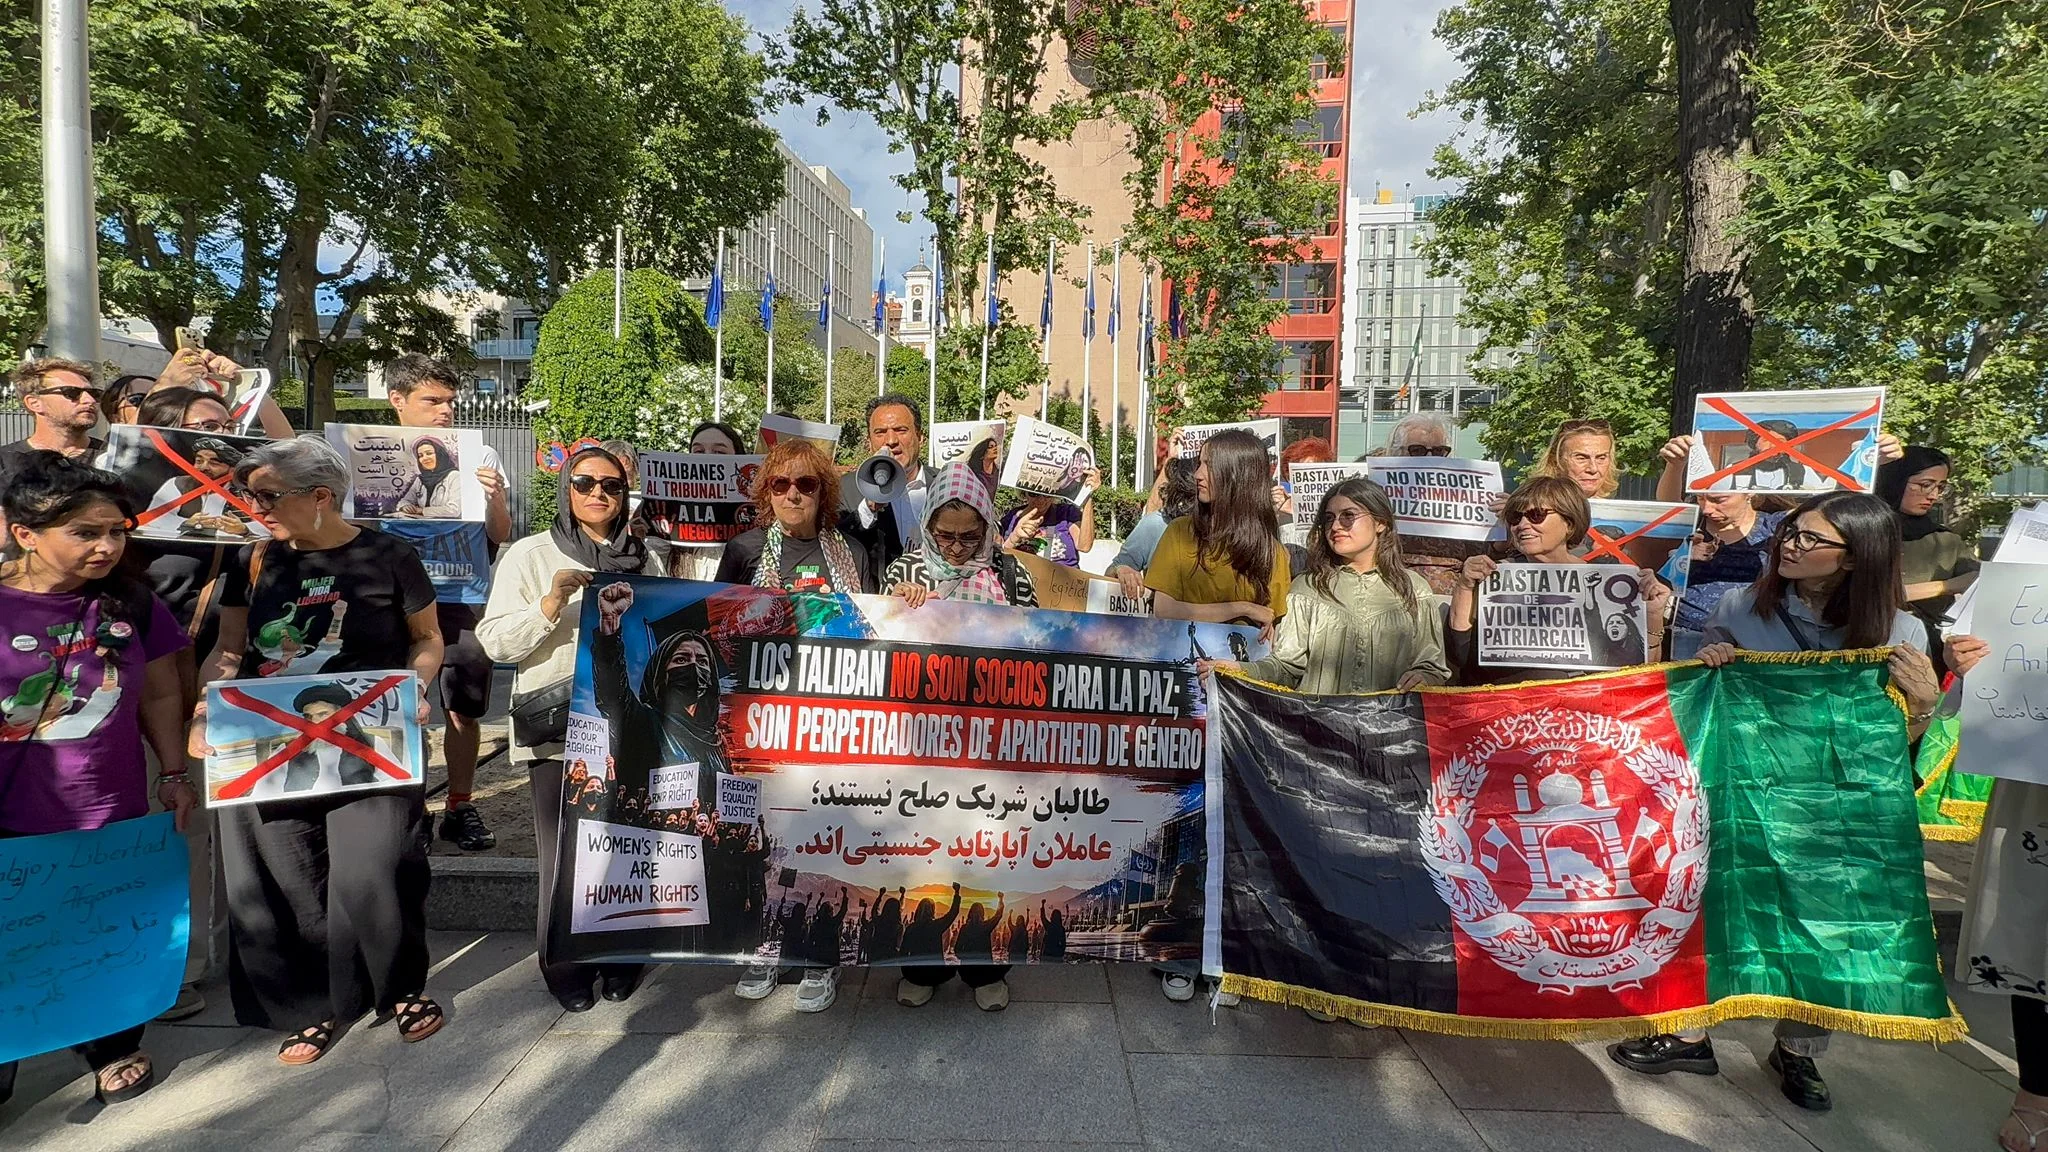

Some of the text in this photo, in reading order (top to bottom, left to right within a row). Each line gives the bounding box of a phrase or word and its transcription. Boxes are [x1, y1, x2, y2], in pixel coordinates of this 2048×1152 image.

[1185, 431, 1196, 440] OS
[647, 460, 725, 481] ¡TALIBANES
[1332, 470, 1345, 481] YA
[646, 480, 728, 499] AL TRIBUNAL!
[1294, 486, 1302, 494] DE
[1386, 472, 1485, 489] NO NEGOCIE
[1408, 486, 1495, 505] CRIMINALES
[678, 504, 716, 522] A LA
[1556, 570, 1580, 592] YA
[296, 592, 340, 606] LIBERTAD
[308, 585, 330, 597] VIDA
[1524, 594, 1540, 604] DE
[1483, 606, 1584, 628] VIOLENCIA
[1484, 628, 1584, 648] PATRIARCAL!
[748, 642, 1180, 720] LOS TALIBAN NO SON SOCIOS PARA LA PAZ;
[570, 730, 598, 743] IS OUR
[746, 702, 1202, 770] SON PERPETRADORES DE APARTHEID DE GÉNERO
[652, 770, 694, 784] EDUCATION
[722, 778, 758, 794] FREEDOM
[668, 788, 692, 802] RIGHT
[722, 792, 757, 806] EQUALITY
[898, 780, 950, 817] صلح
[956, 783, 1028, 820] شریک
[1032, 786, 1110, 822] طالبان
[722, 804, 756, 818] JUSTICE
[588, 833, 698, 860] WOMEN'S RIGHTS
[948, 826, 1032, 870] آپارتاید
[1032, 832, 1112, 868] عاملان
[630, 861, 660, 880] ARE
[585, 884, 700, 906] HUMAN RIGHTS
